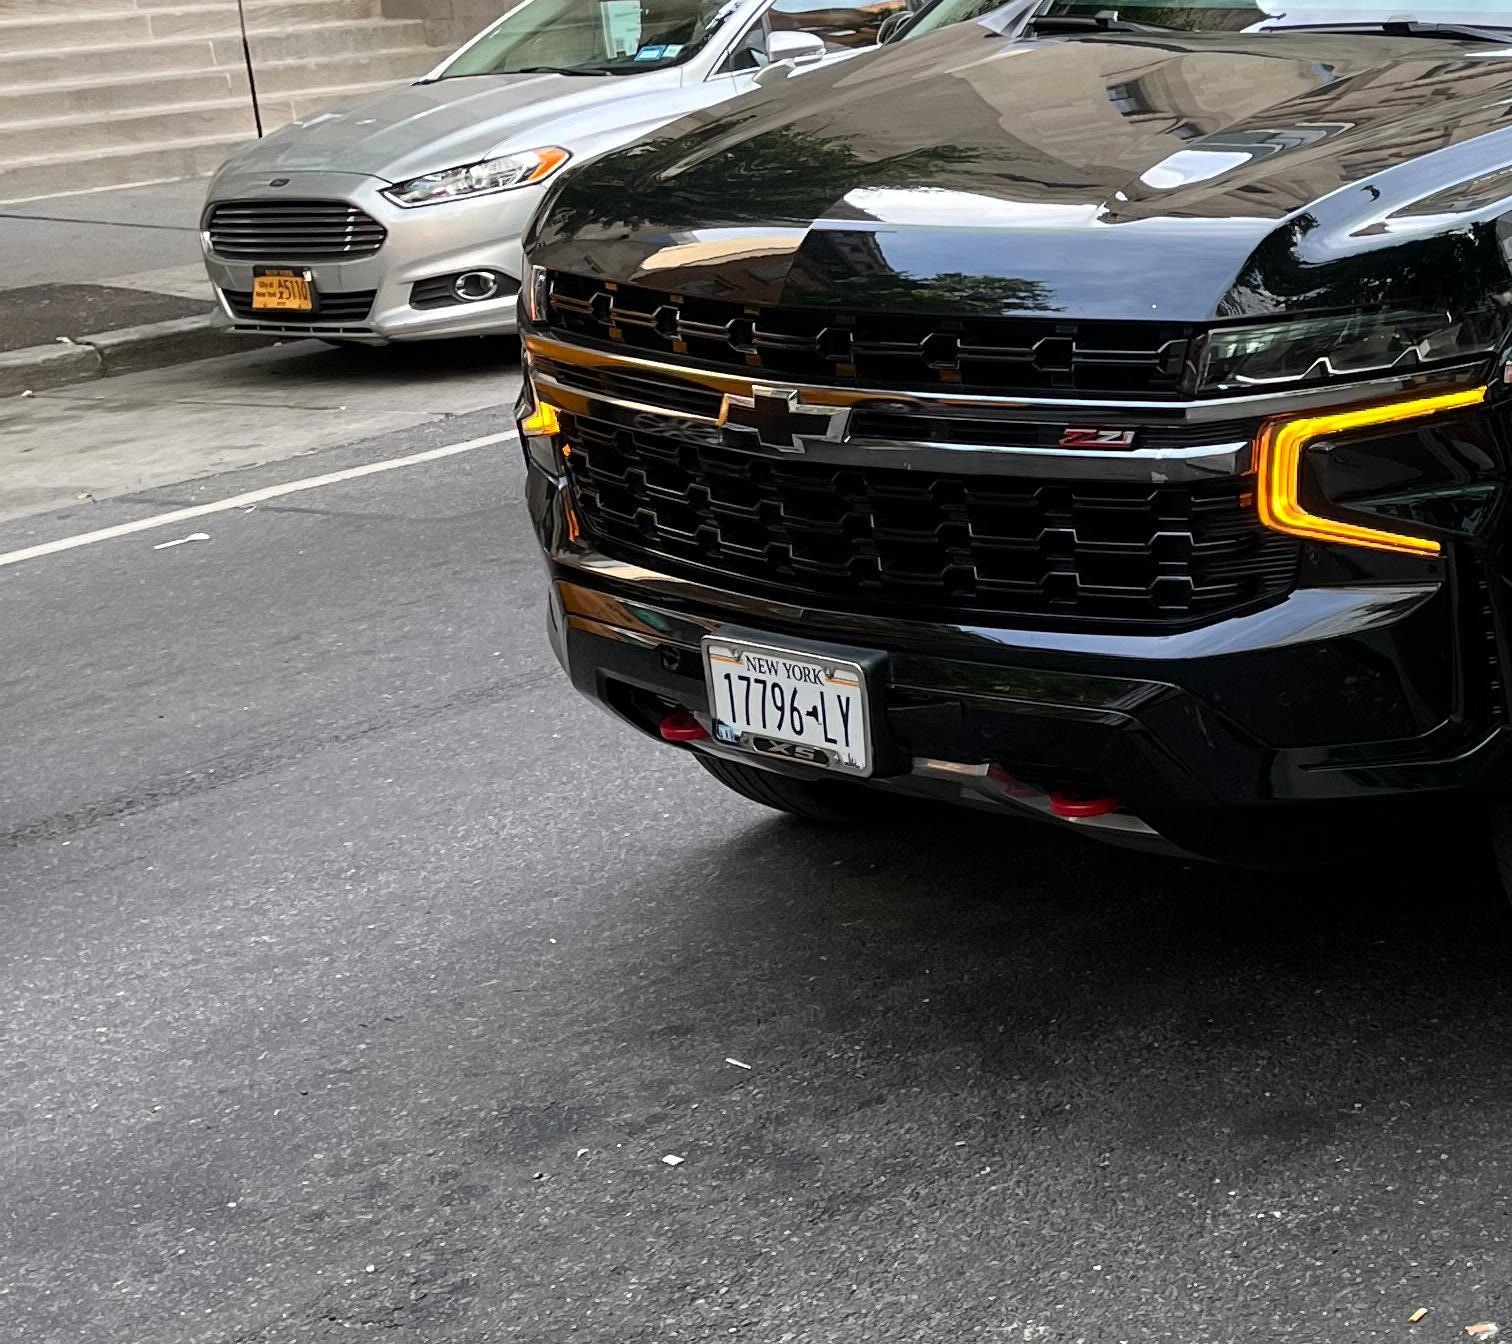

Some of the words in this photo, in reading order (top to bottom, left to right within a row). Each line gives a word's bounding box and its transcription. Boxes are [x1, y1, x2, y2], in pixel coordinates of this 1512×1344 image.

[1058, 428, 1136, 448] Z71
[745, 655, 780, 677] NEW
[782, 663, 825, 687] YORK
